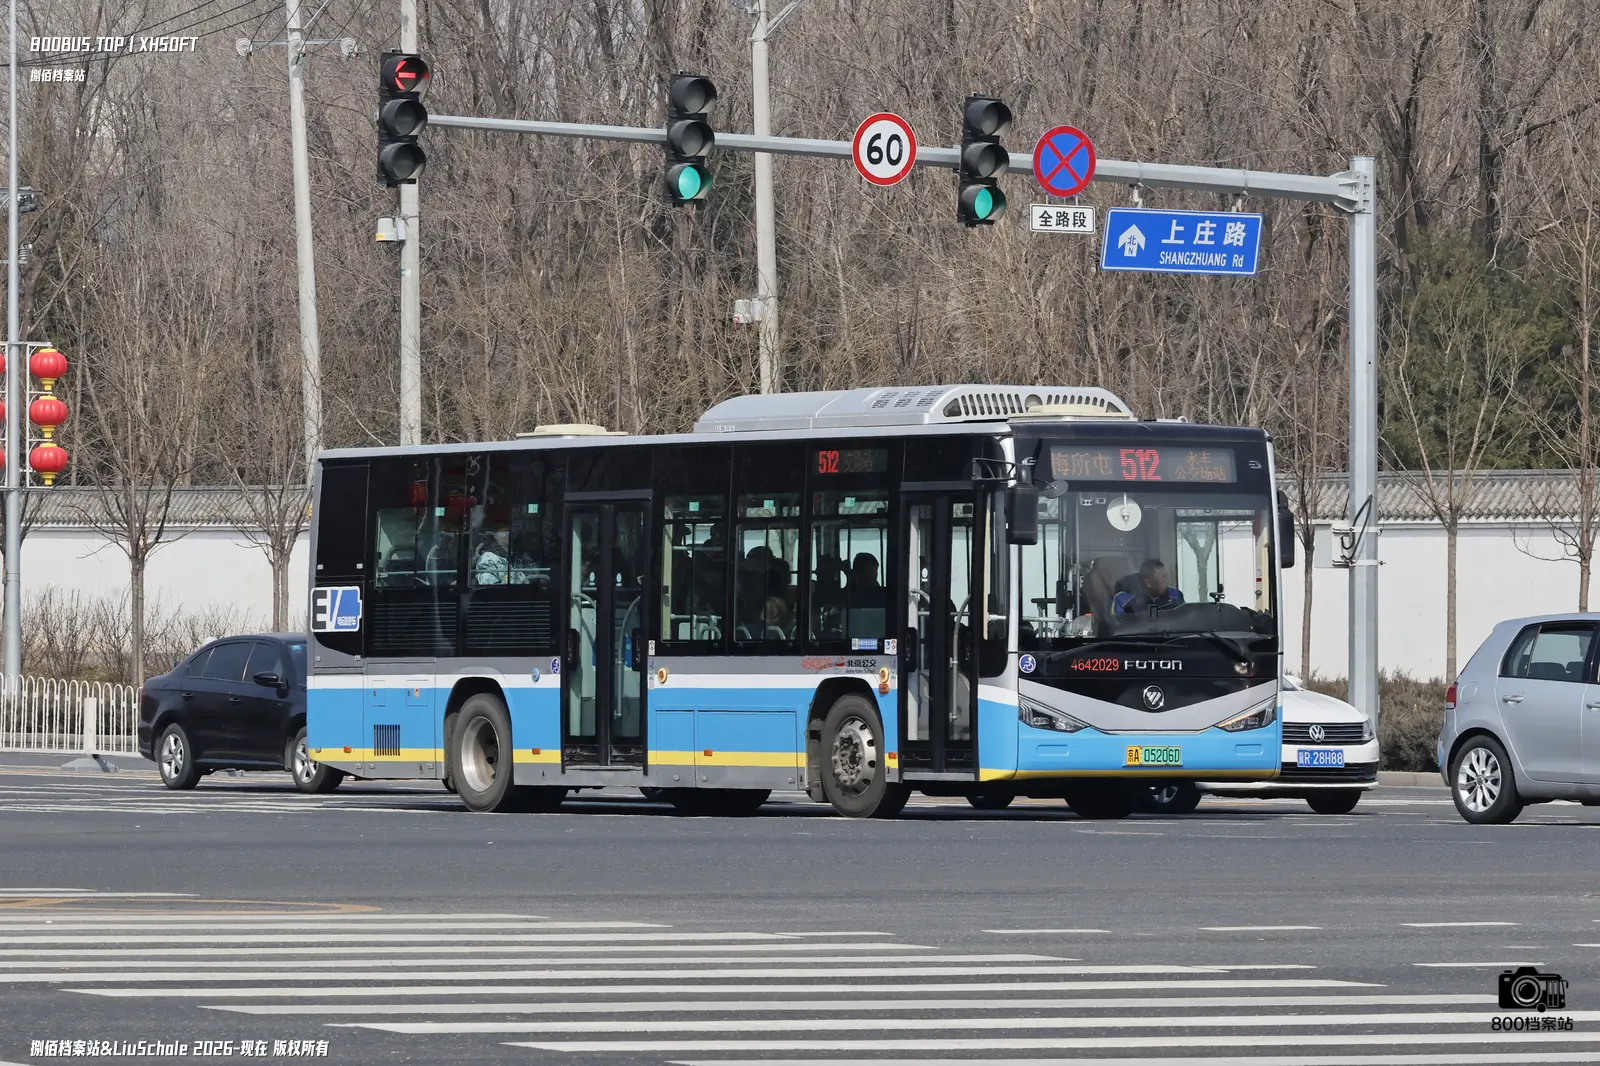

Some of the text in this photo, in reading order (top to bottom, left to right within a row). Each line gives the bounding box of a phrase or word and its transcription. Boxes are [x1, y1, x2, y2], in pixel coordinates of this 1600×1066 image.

[867, 133, 903, 166] 60
[1039, 210, 1087, 228] 全路段
[1127, 235, 1136, 246] 北
[1161, 219, 1246, 247] 上庄路
[1159, 251, 1244, 268] SHANGZHUANG Rd
[818, 450, 839, 474] 512
[1120, 448, 1162, 480] 512
[846, 659, 877, 668] 北京公交
[1071, 658, 1120, 671] 4642029
